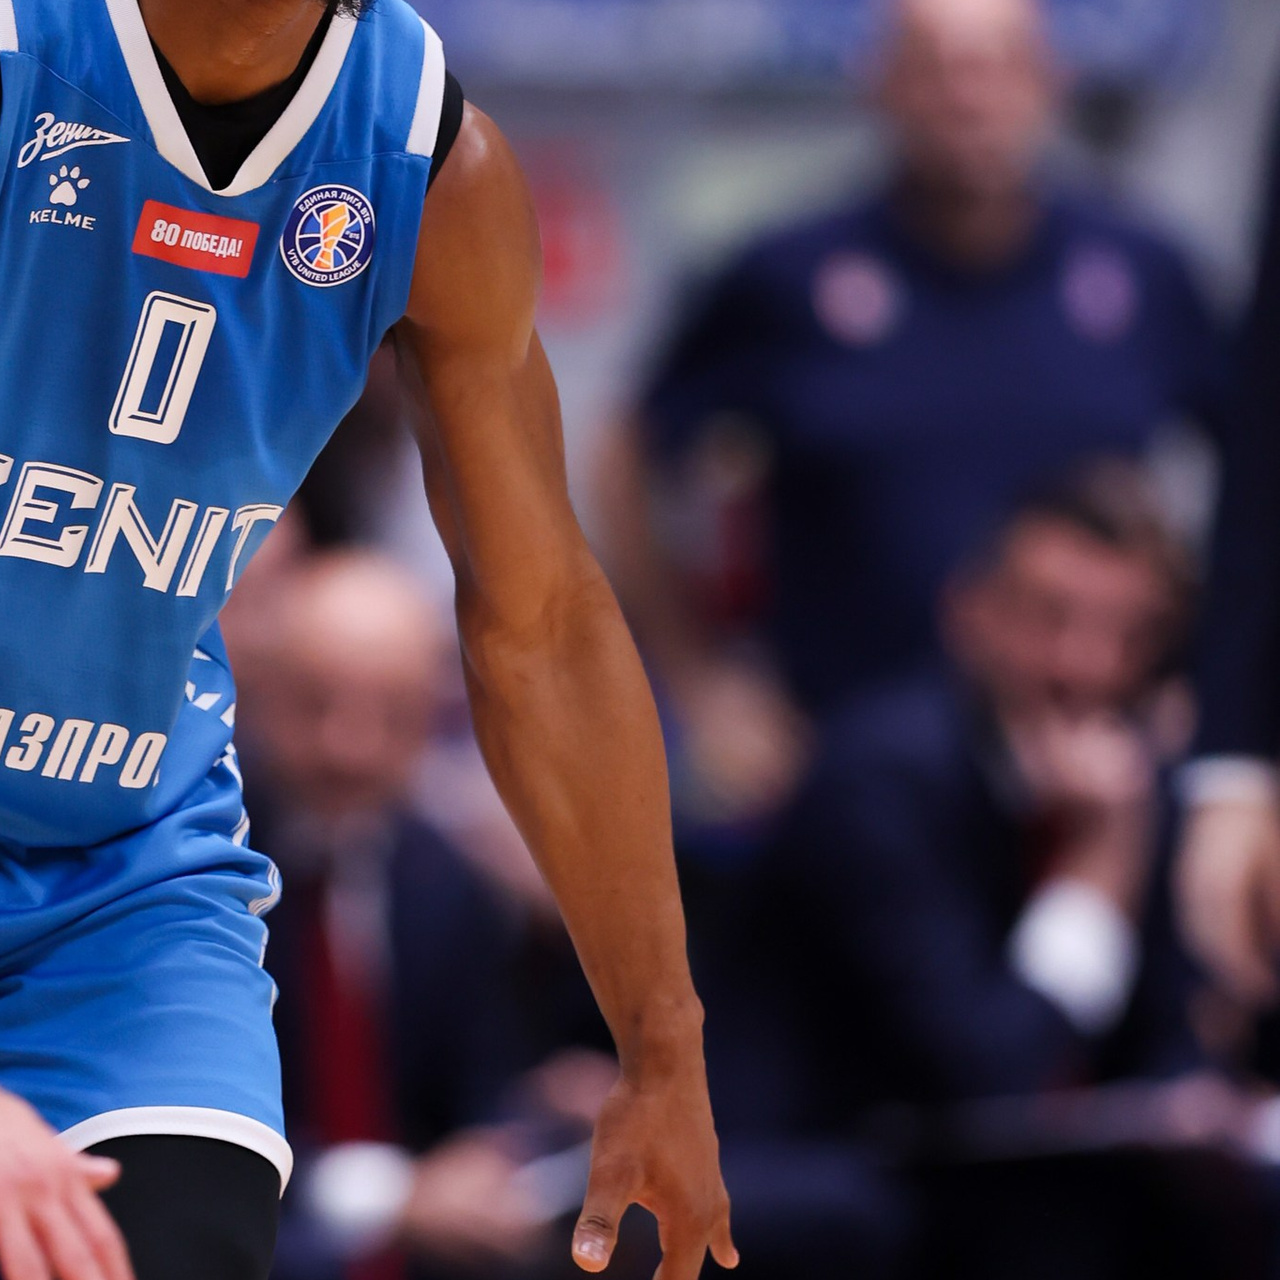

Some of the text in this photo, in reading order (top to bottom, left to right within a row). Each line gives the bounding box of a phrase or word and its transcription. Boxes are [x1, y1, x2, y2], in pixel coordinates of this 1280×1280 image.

[17, 112, 131, 168] Зенит
[29, 209, 97, 231] KELME
[298, 190, 371, 224] ЕДИНАЯ ЛИГА ВТБ
[150, 219, 243, 258] 80 ПОБЕДА!
[287, 248, 361, 282] VTB UNITED LEAGUE
[108, 290, 217, 445] 0
